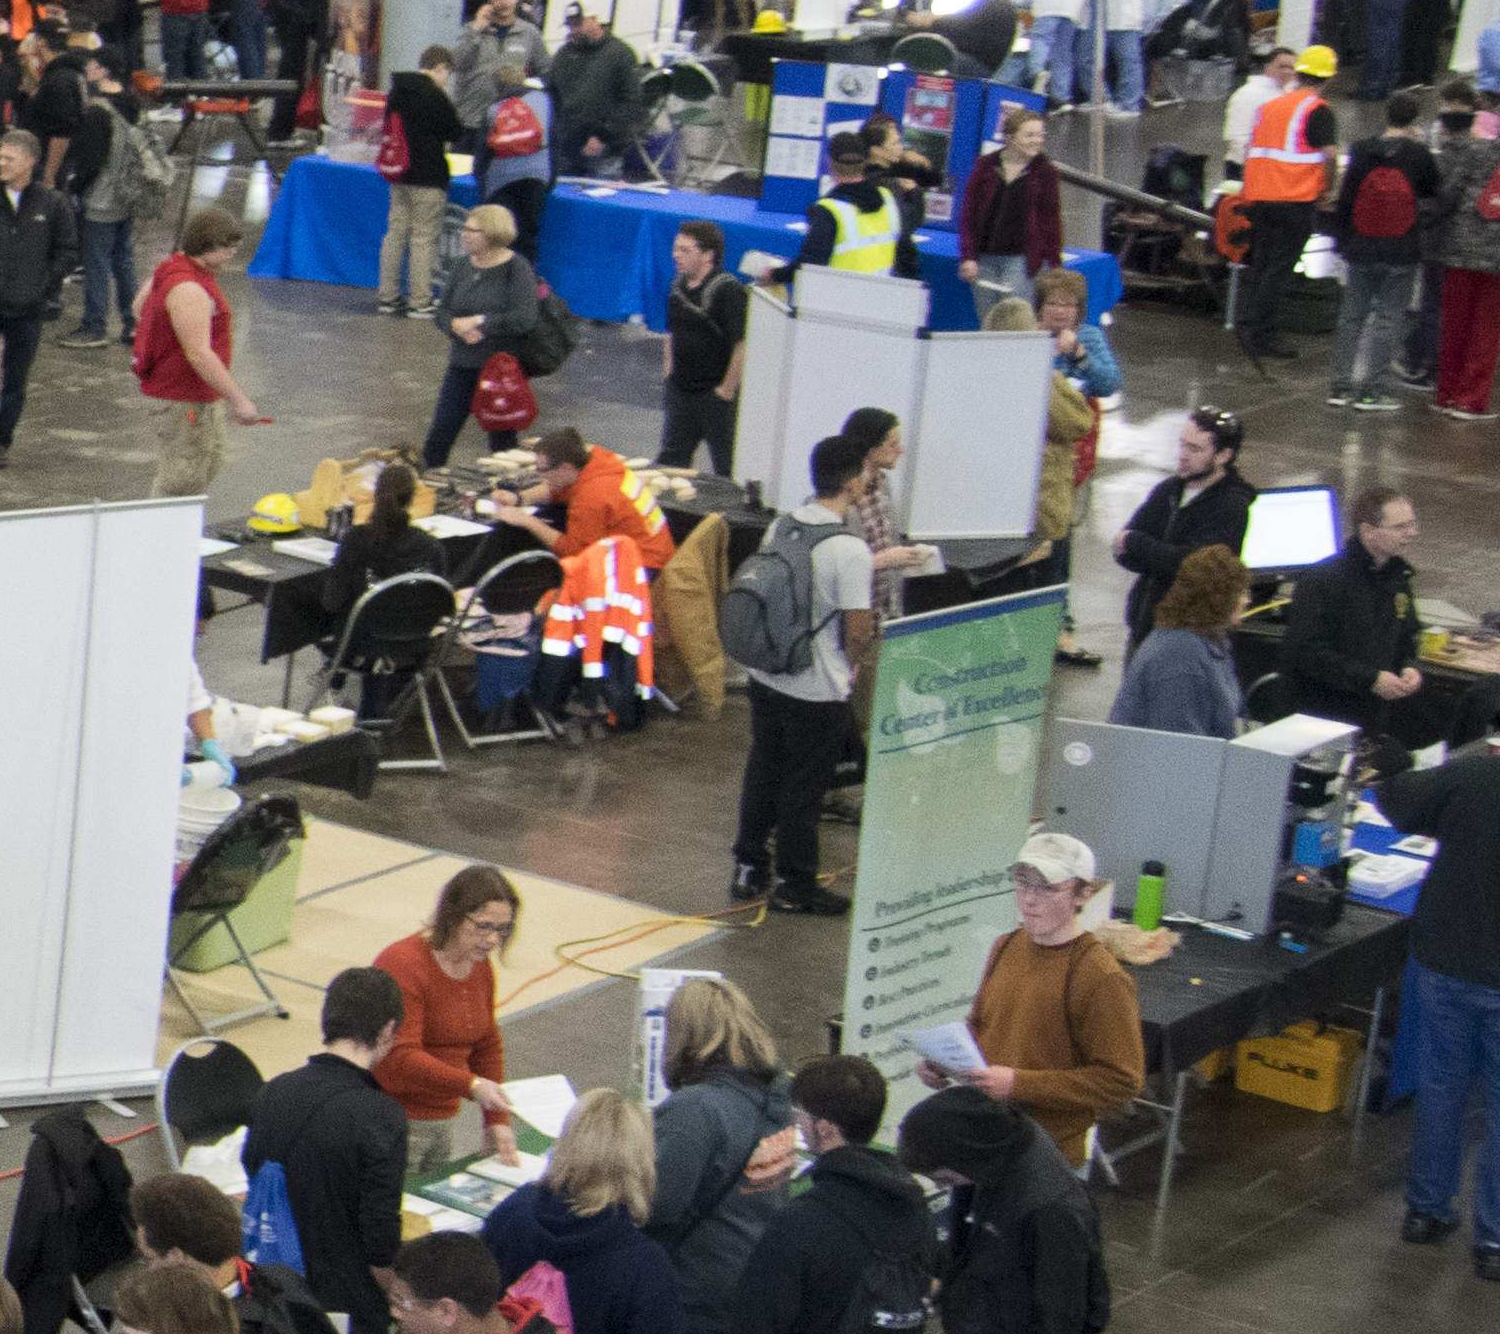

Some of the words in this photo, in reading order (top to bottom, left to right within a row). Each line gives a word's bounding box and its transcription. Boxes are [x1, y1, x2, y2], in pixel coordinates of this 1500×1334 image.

[913, 656, 1029, 694] Construction
[880, 706, 938, 737] Center
[944, 699, 960, 722] of
[875, 890, 934, 918] Providing
[1246, 1051, 1319, 1081] FLUKE
